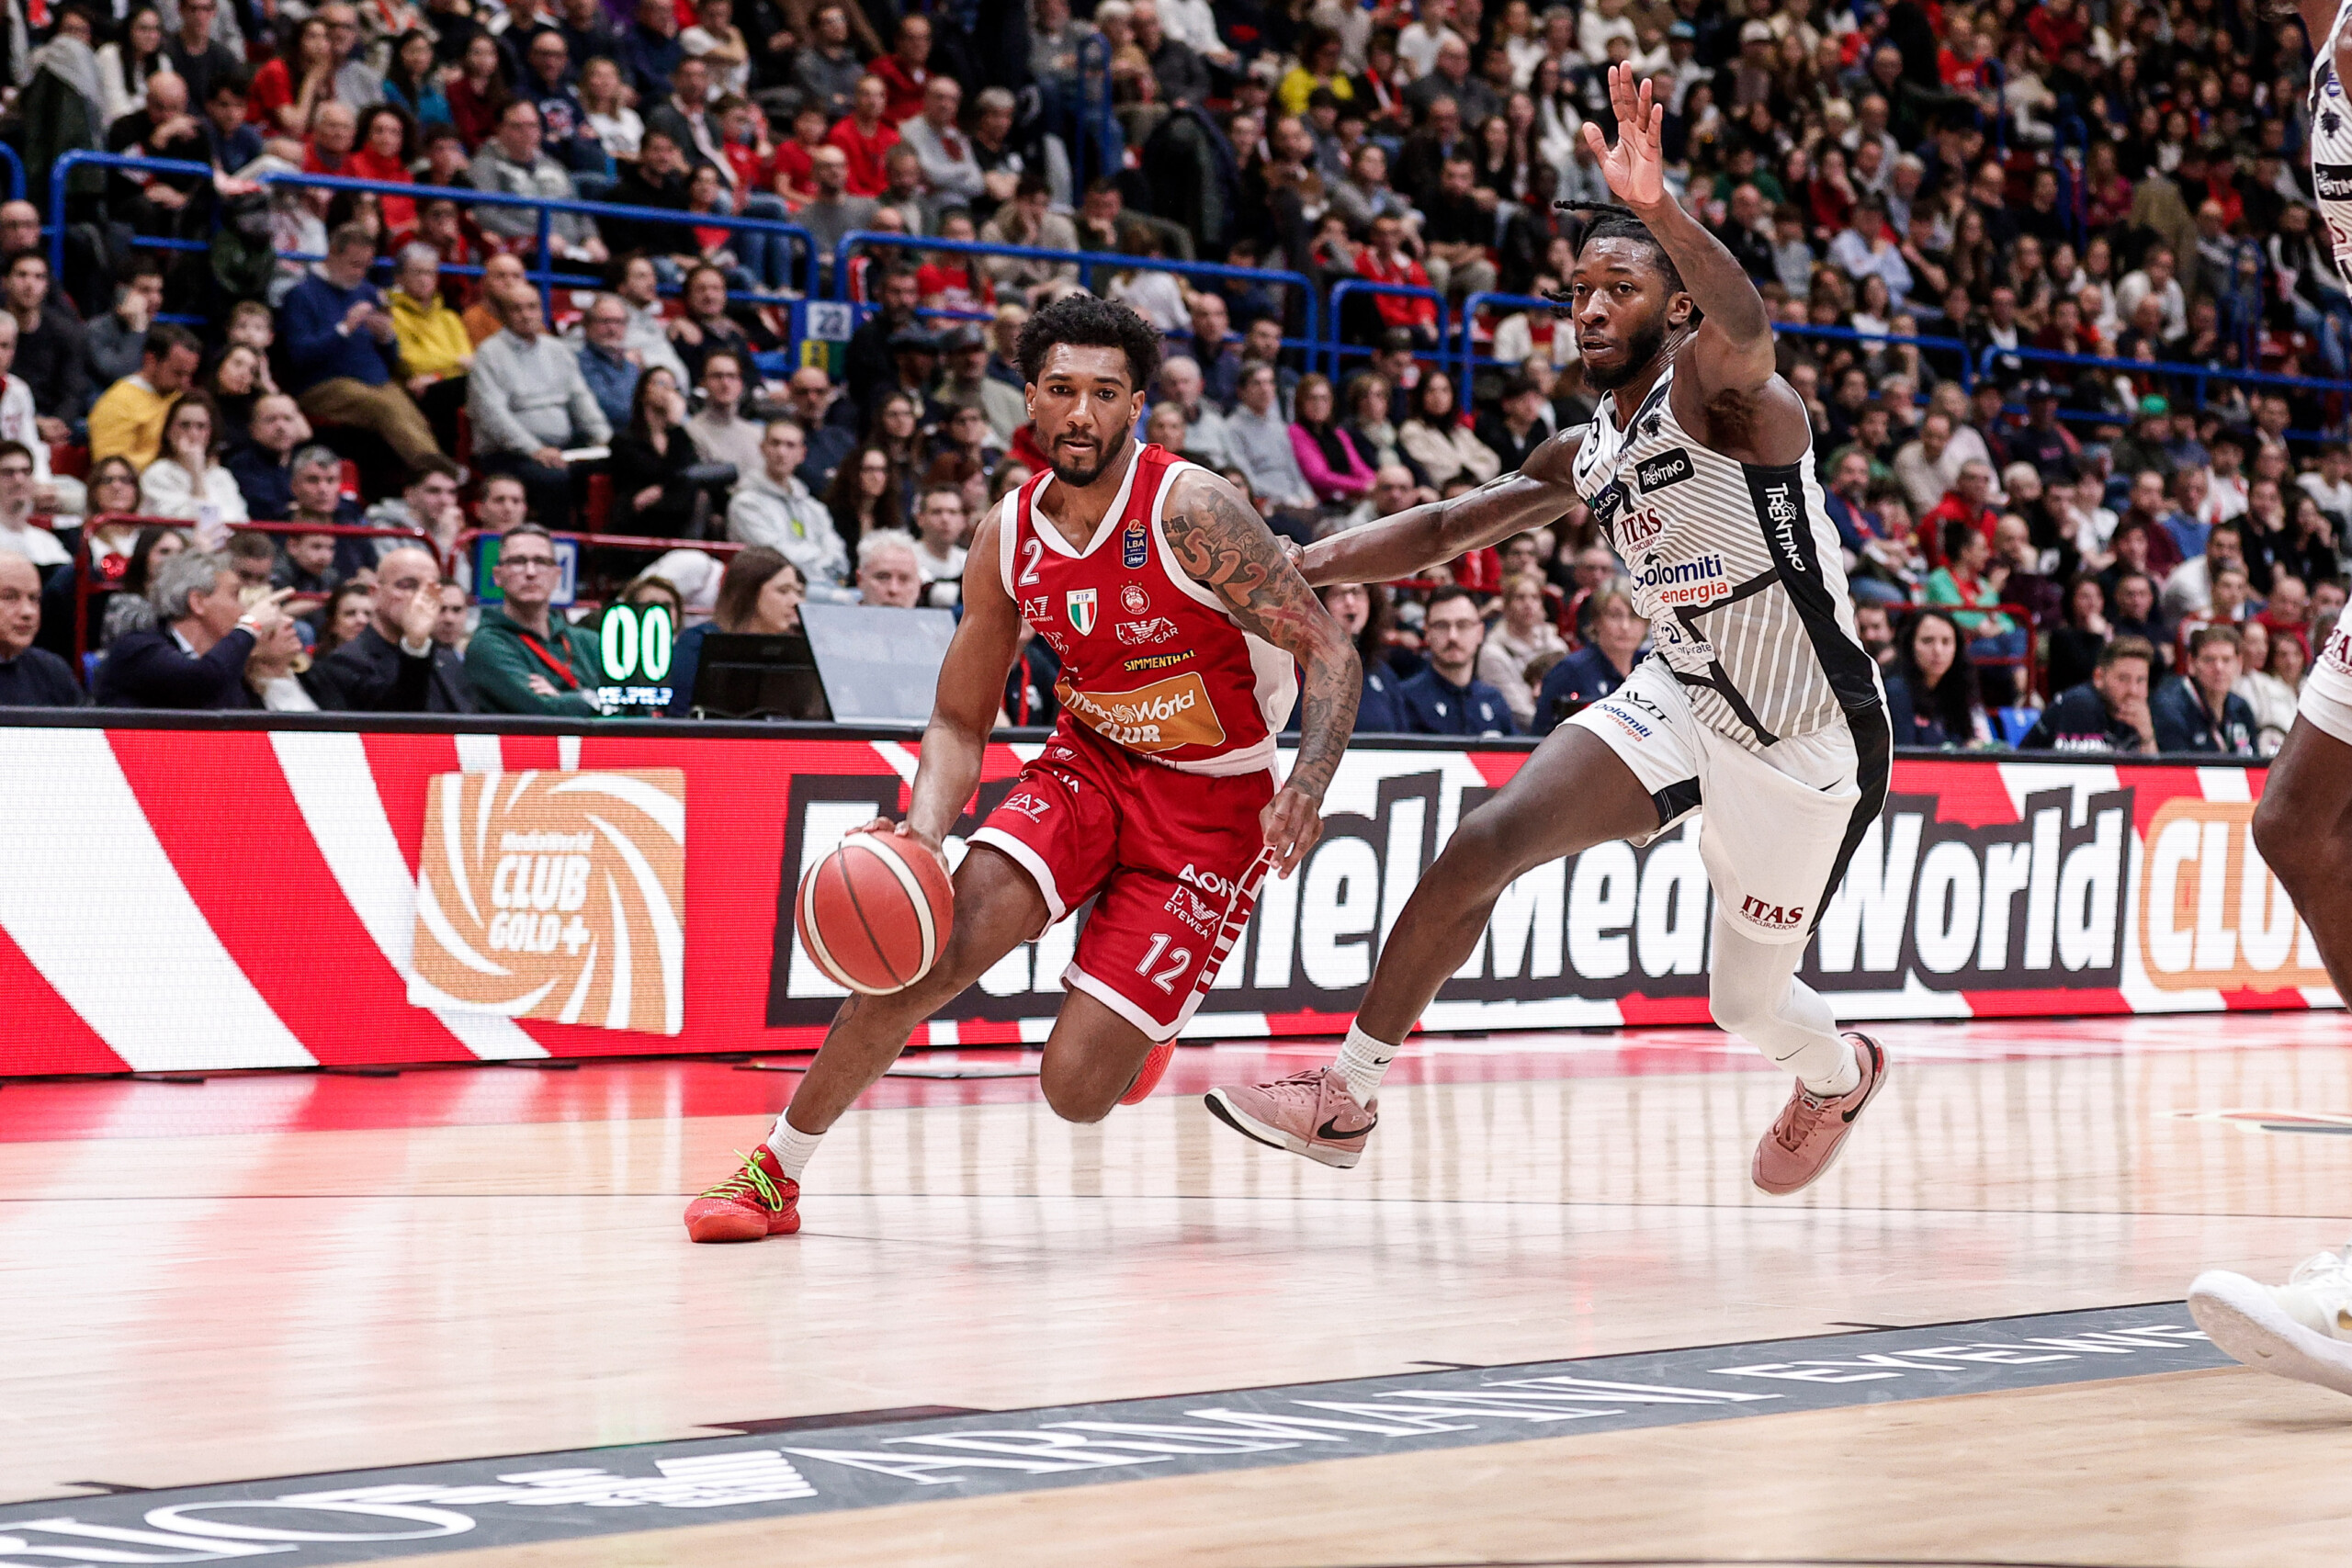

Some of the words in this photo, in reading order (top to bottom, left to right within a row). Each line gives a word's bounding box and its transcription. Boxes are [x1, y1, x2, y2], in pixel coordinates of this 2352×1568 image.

[1642, 459, 1685, 486] TRENTINO
[1621, 508, 1663, 546] ITAS
[1765, 482, 1806, 571] TRENTINO
[1126, 539, 1145, 549] LBA
[1018, 536, 1045, 587] 2
[1017, 595, 1049, 619] A7
[1076, 593, 1091, 603] FIP
[1660, 581, 1728, 604] energia
[600, 604, 673, 682] 00
[1122, 626, 1180, 646] EYEEAR
[1124, 649, 1197, 671] SIMMENTHAL
[492, 853, 593, 911] CLUB
[2148, 818, 2326, 975] CLU
[1163, 900, 1211, 941] EYEWEA
[1741, 894, 1804, 924] ITAS
[1135, 932, 1193, 996] 12
